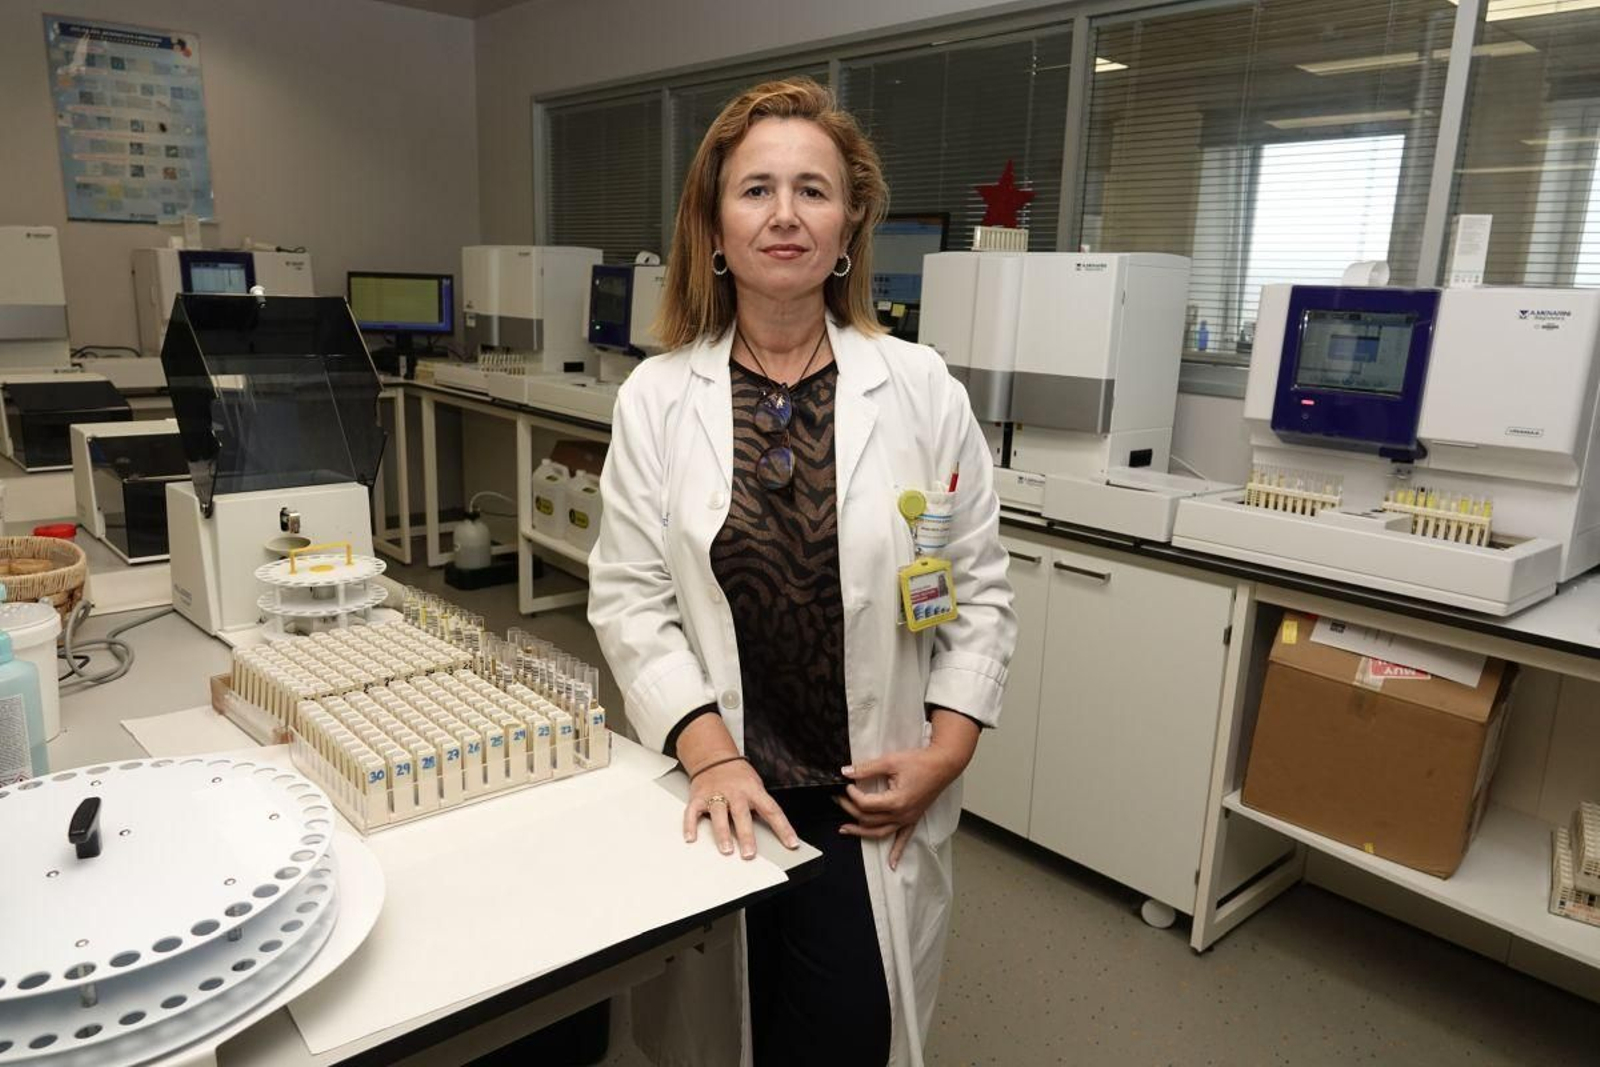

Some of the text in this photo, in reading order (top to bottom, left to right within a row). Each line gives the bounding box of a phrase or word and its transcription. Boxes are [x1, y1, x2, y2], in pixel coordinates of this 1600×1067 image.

[468, 742, 480, 754] 26
[490, 736, 503, 748] 25
[396, 762, 411, 777] 29
[369, 769, 385, 784] 30
